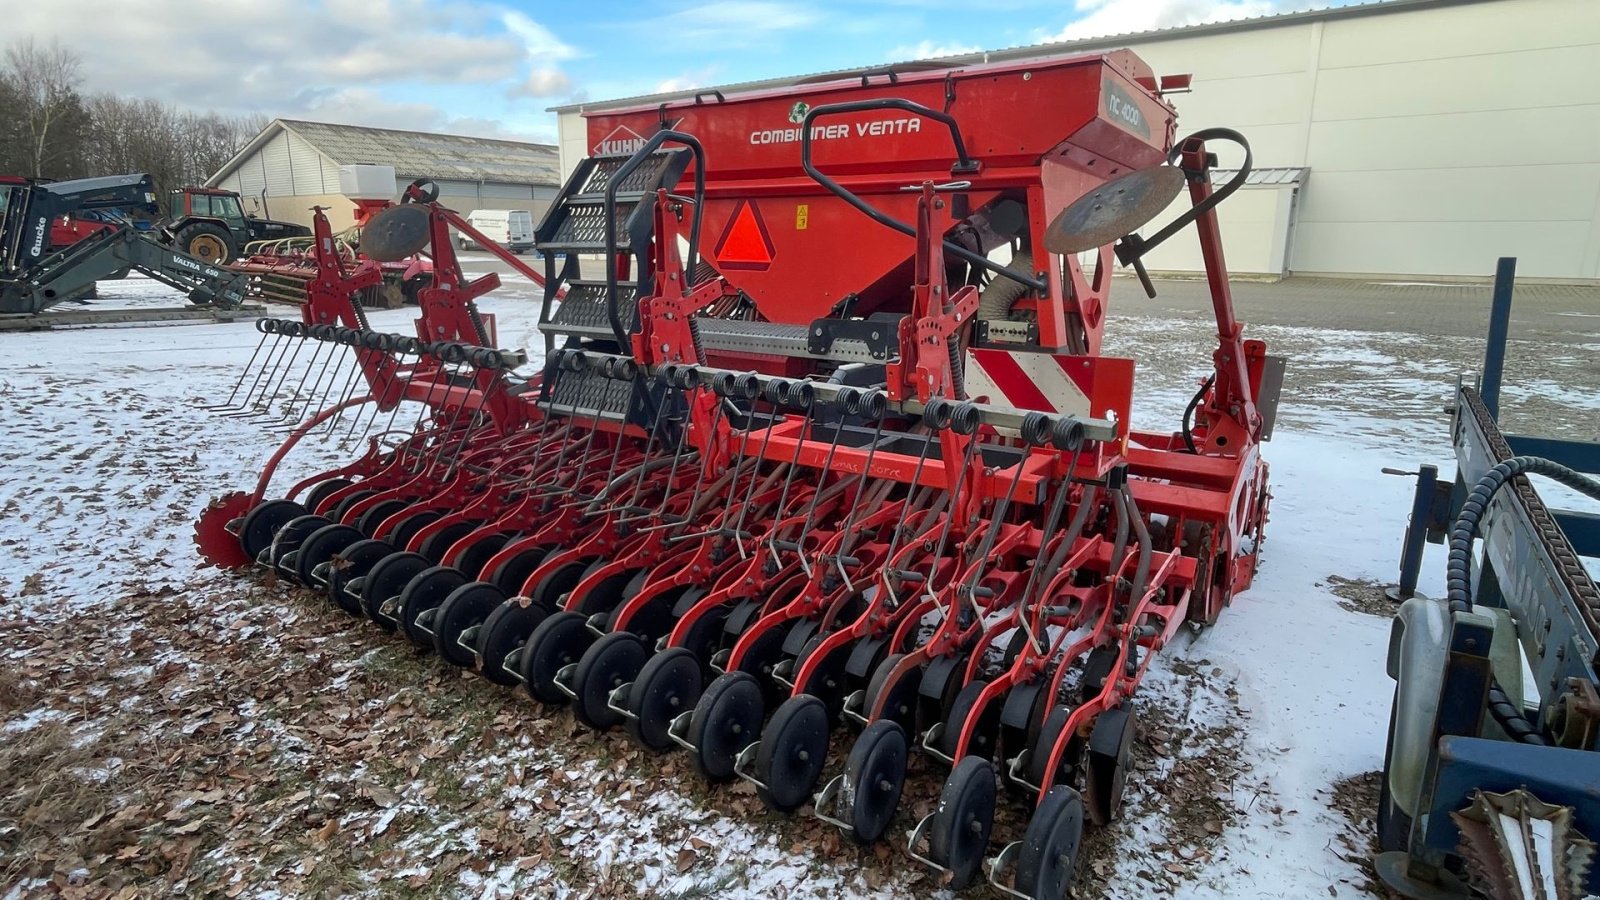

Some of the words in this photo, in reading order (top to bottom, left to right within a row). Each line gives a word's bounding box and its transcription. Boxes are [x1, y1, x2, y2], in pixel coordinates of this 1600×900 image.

[856, 117, 921, 137] VENTA
[601, 138, 645, 156] KUHN
[30, 216, 47, 257] Quicke
[173, 255, 200, 271] VALTRA
[205, 267, 219, 277] 650
